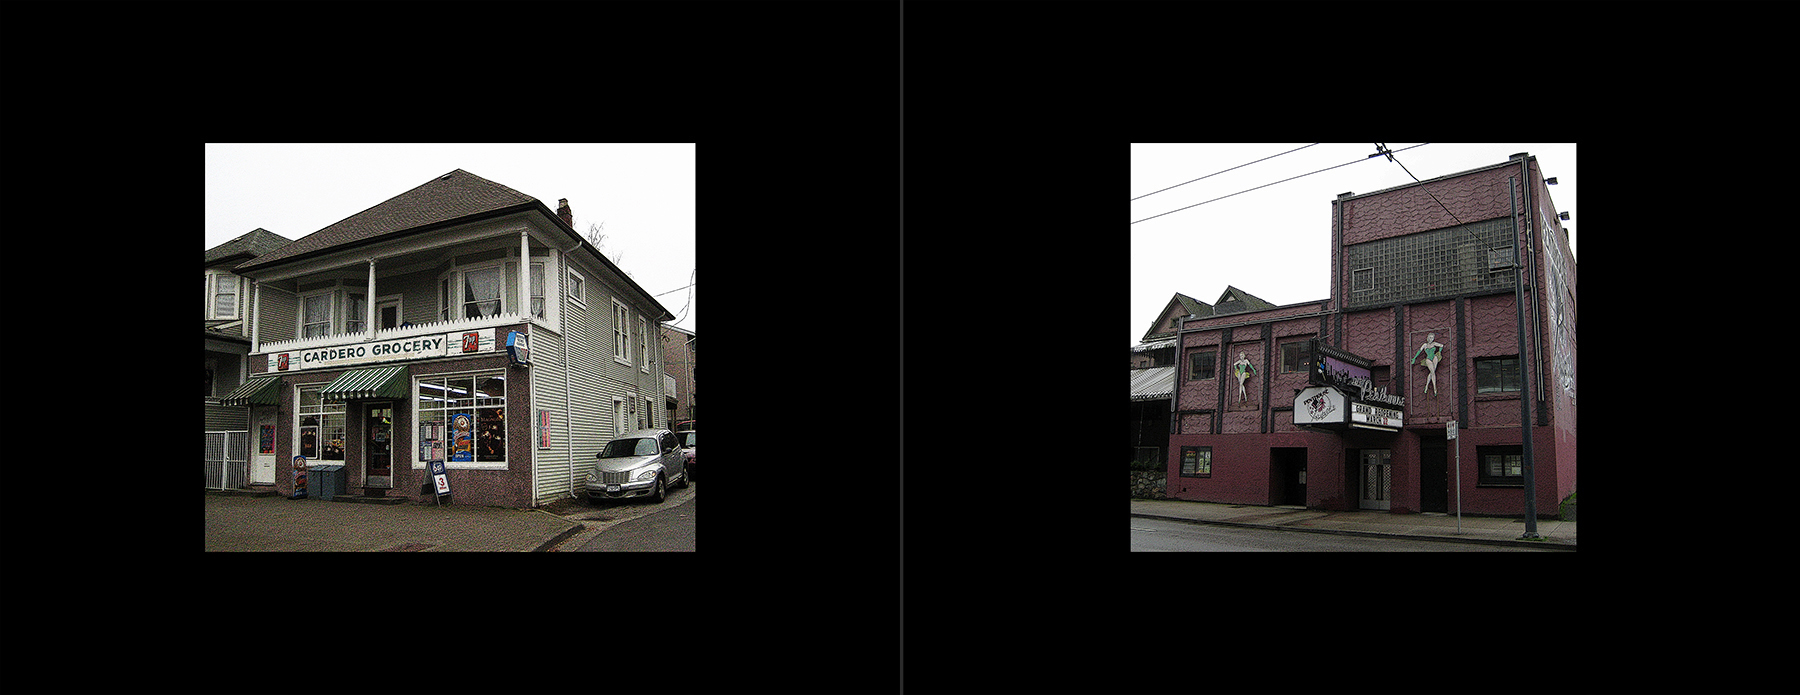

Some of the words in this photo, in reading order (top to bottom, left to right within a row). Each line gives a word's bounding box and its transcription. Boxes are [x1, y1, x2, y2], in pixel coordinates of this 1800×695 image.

[304, 346, 366, 363] CARDERO
[372, 338, 442, 356] GROCERY
[1355, 404, 1372, 415] GRAND
[1365, 414, 1382, 425] MARCH
